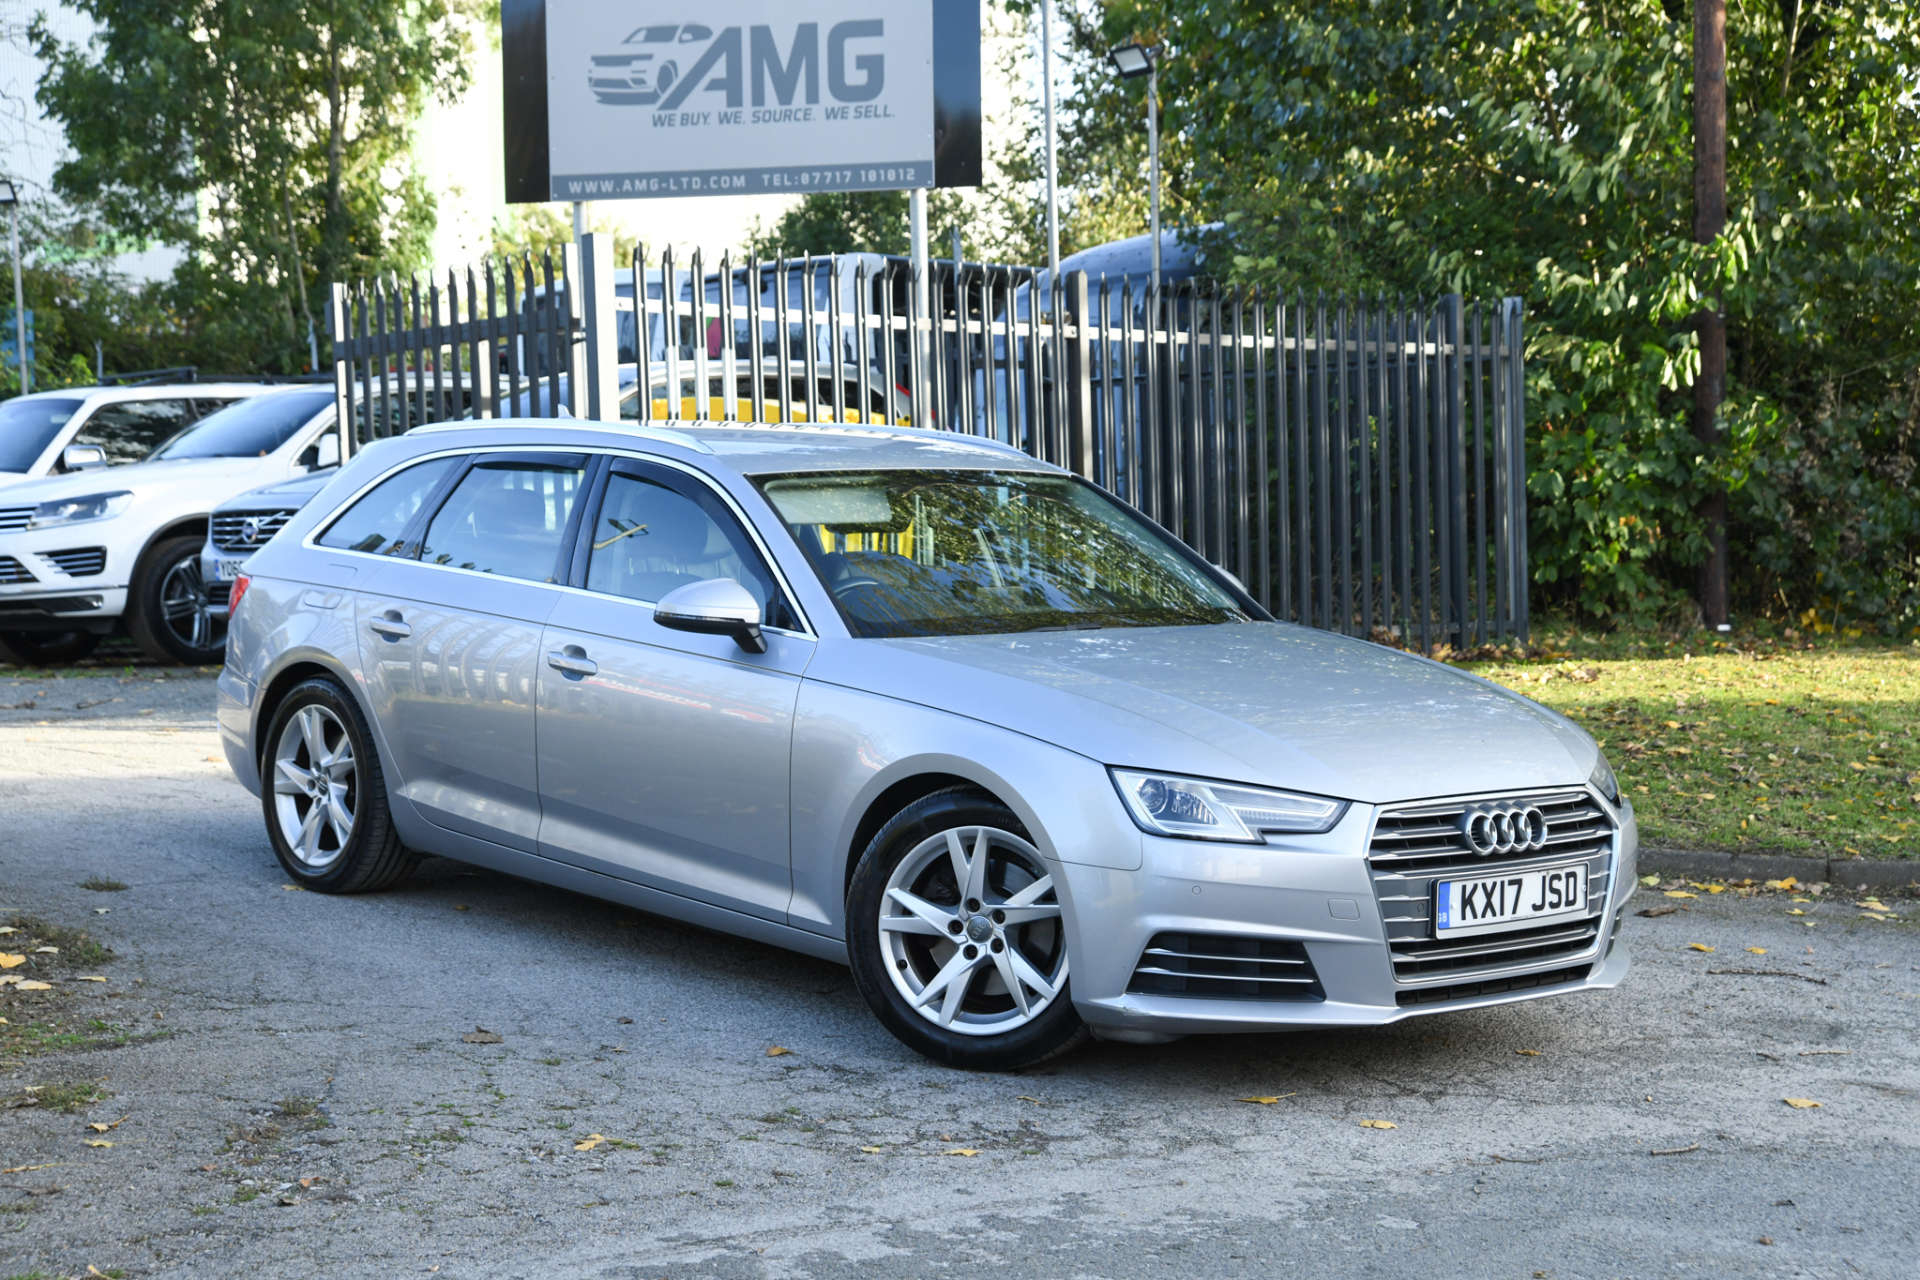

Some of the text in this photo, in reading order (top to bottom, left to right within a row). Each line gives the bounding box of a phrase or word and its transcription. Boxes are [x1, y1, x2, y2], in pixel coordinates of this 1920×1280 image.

[656, 19, 884, 110] AMG
[652, 113, 677, 127] WE
[751, 107, 816, 124] SOURCE.
[825, 106, 849, 120] WE
[853, 104, 896, 119] SELL.
[568, 175, 746, 194] WWW.AMG-LTD.COM
[762, 172, 851, 187] TEL:07717
[1461, 871, 1577, 921] KX17 JSD
